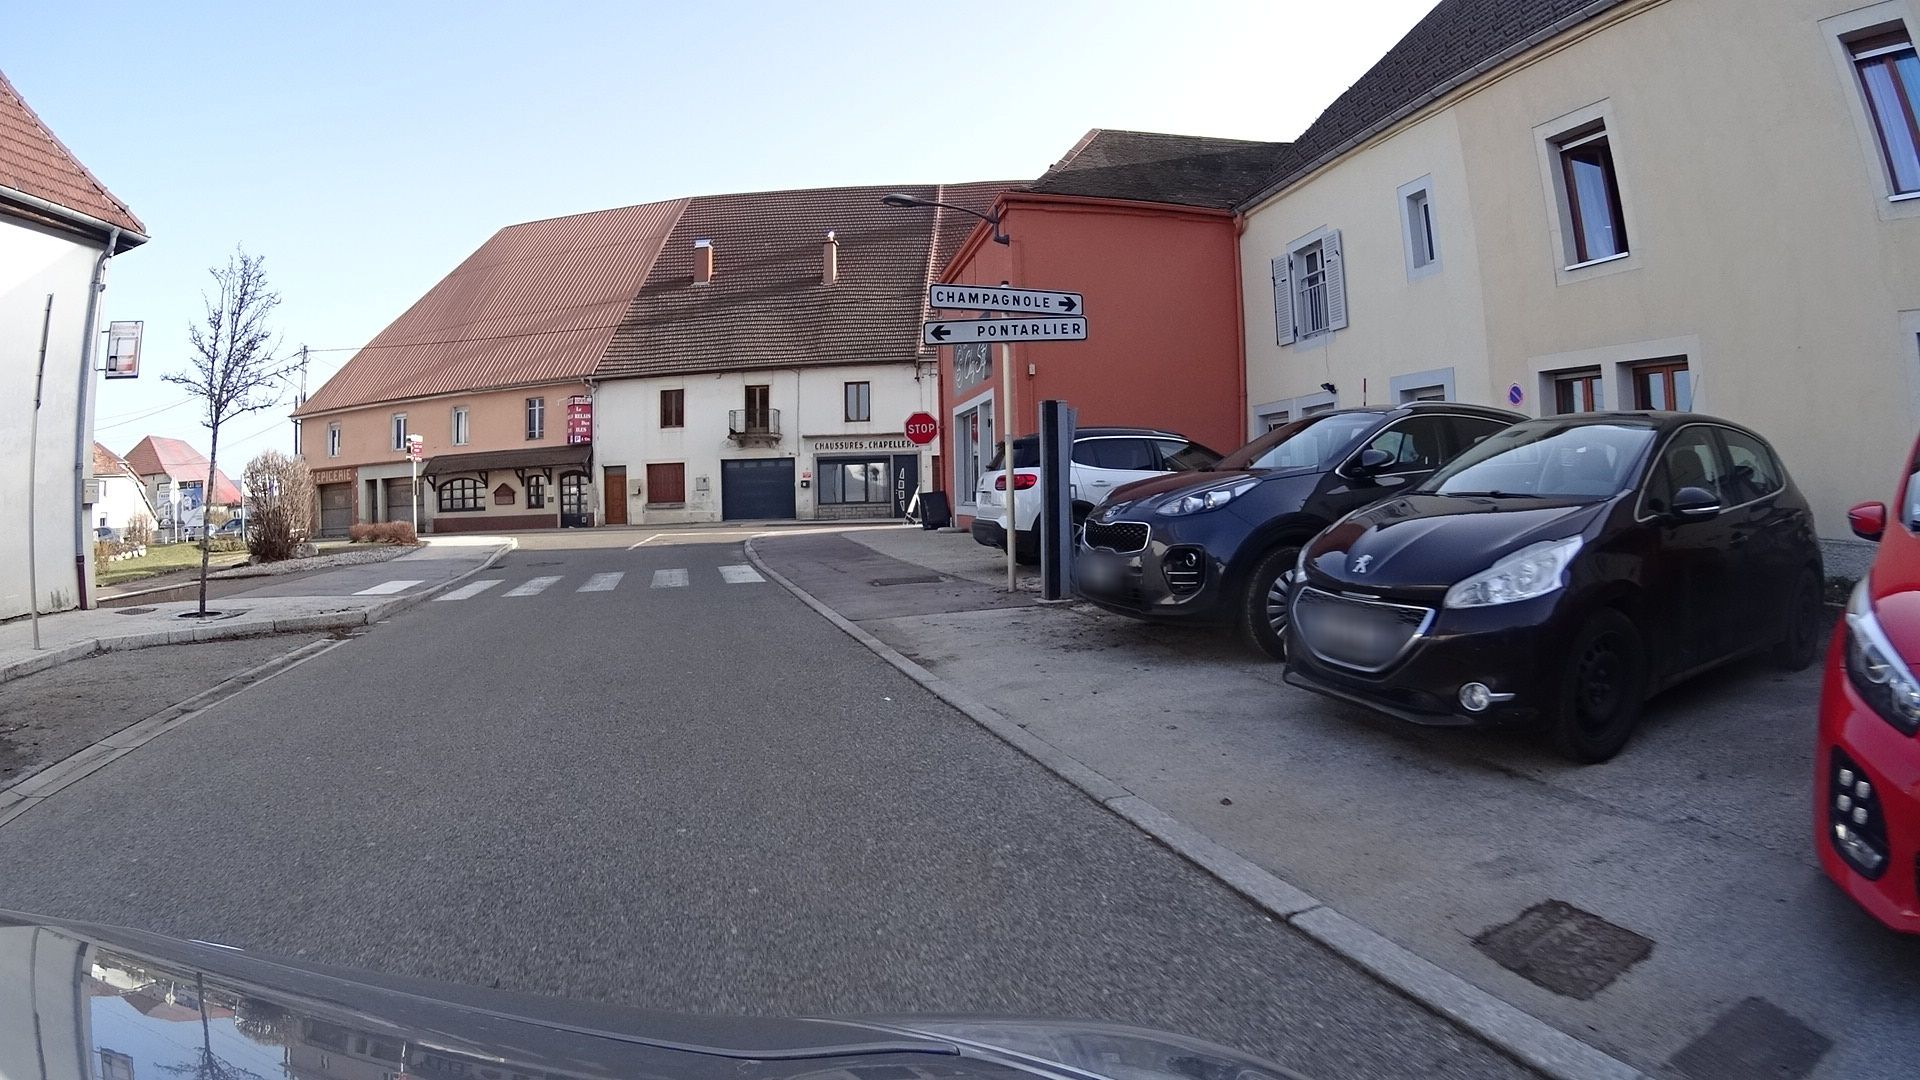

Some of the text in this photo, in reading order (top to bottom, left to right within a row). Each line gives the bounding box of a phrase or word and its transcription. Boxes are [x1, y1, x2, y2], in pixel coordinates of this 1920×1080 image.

[936, 291, 1050, 308] CHAMPAGNOLE
[977, 323, 1081, 337] PONTARLIER
[908, 423, 935, 434] STOP
[868, 440, 920, 449] CHAPELLERI
[316, 468, 352, 482] EPICERIE
